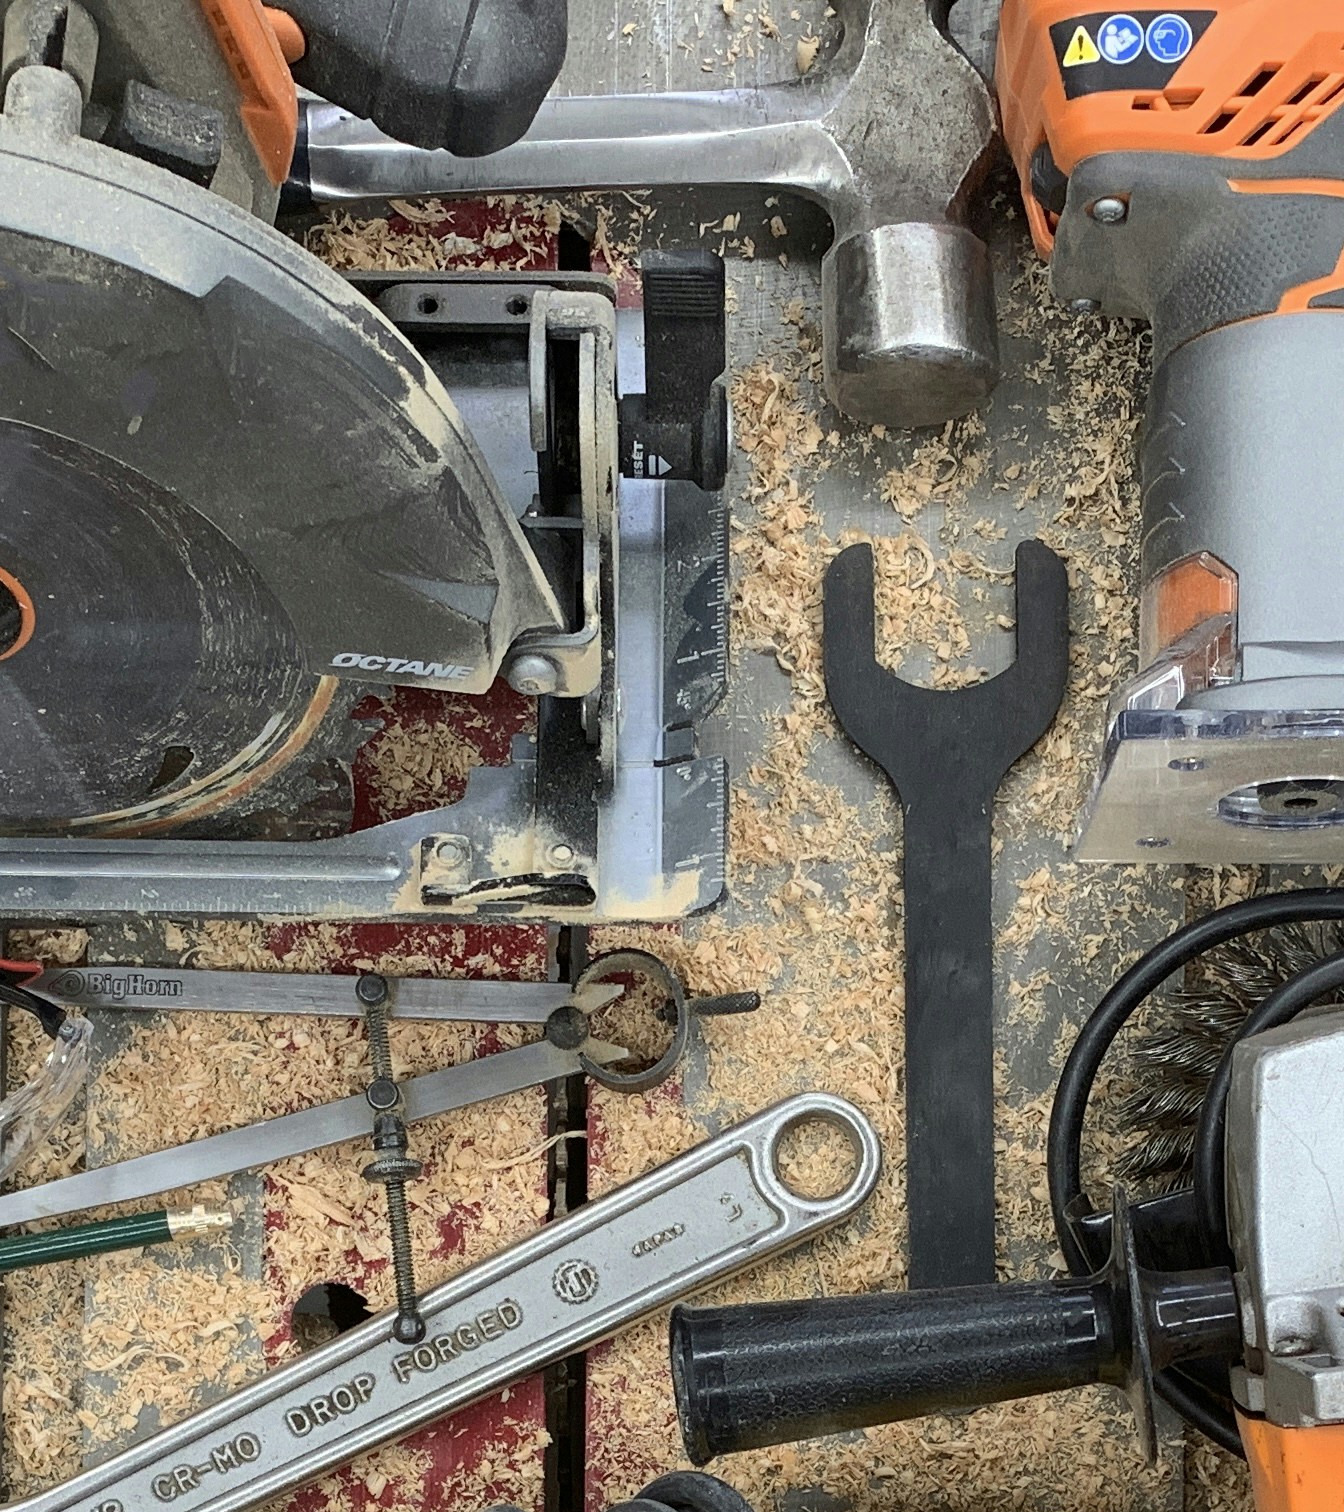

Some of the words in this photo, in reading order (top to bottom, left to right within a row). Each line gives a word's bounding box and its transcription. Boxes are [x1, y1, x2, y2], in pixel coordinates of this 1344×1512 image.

[633, 440, 644, 479] ESET
[328, 653, 475, 680] OCTANE
[87, 973, 183, 1000] BigHorn
[150, 1432, 262, 1503] CR-MO
[285, 1372, 377, 1438] DROP
[391, 1297, 525, 1385] FORGED
